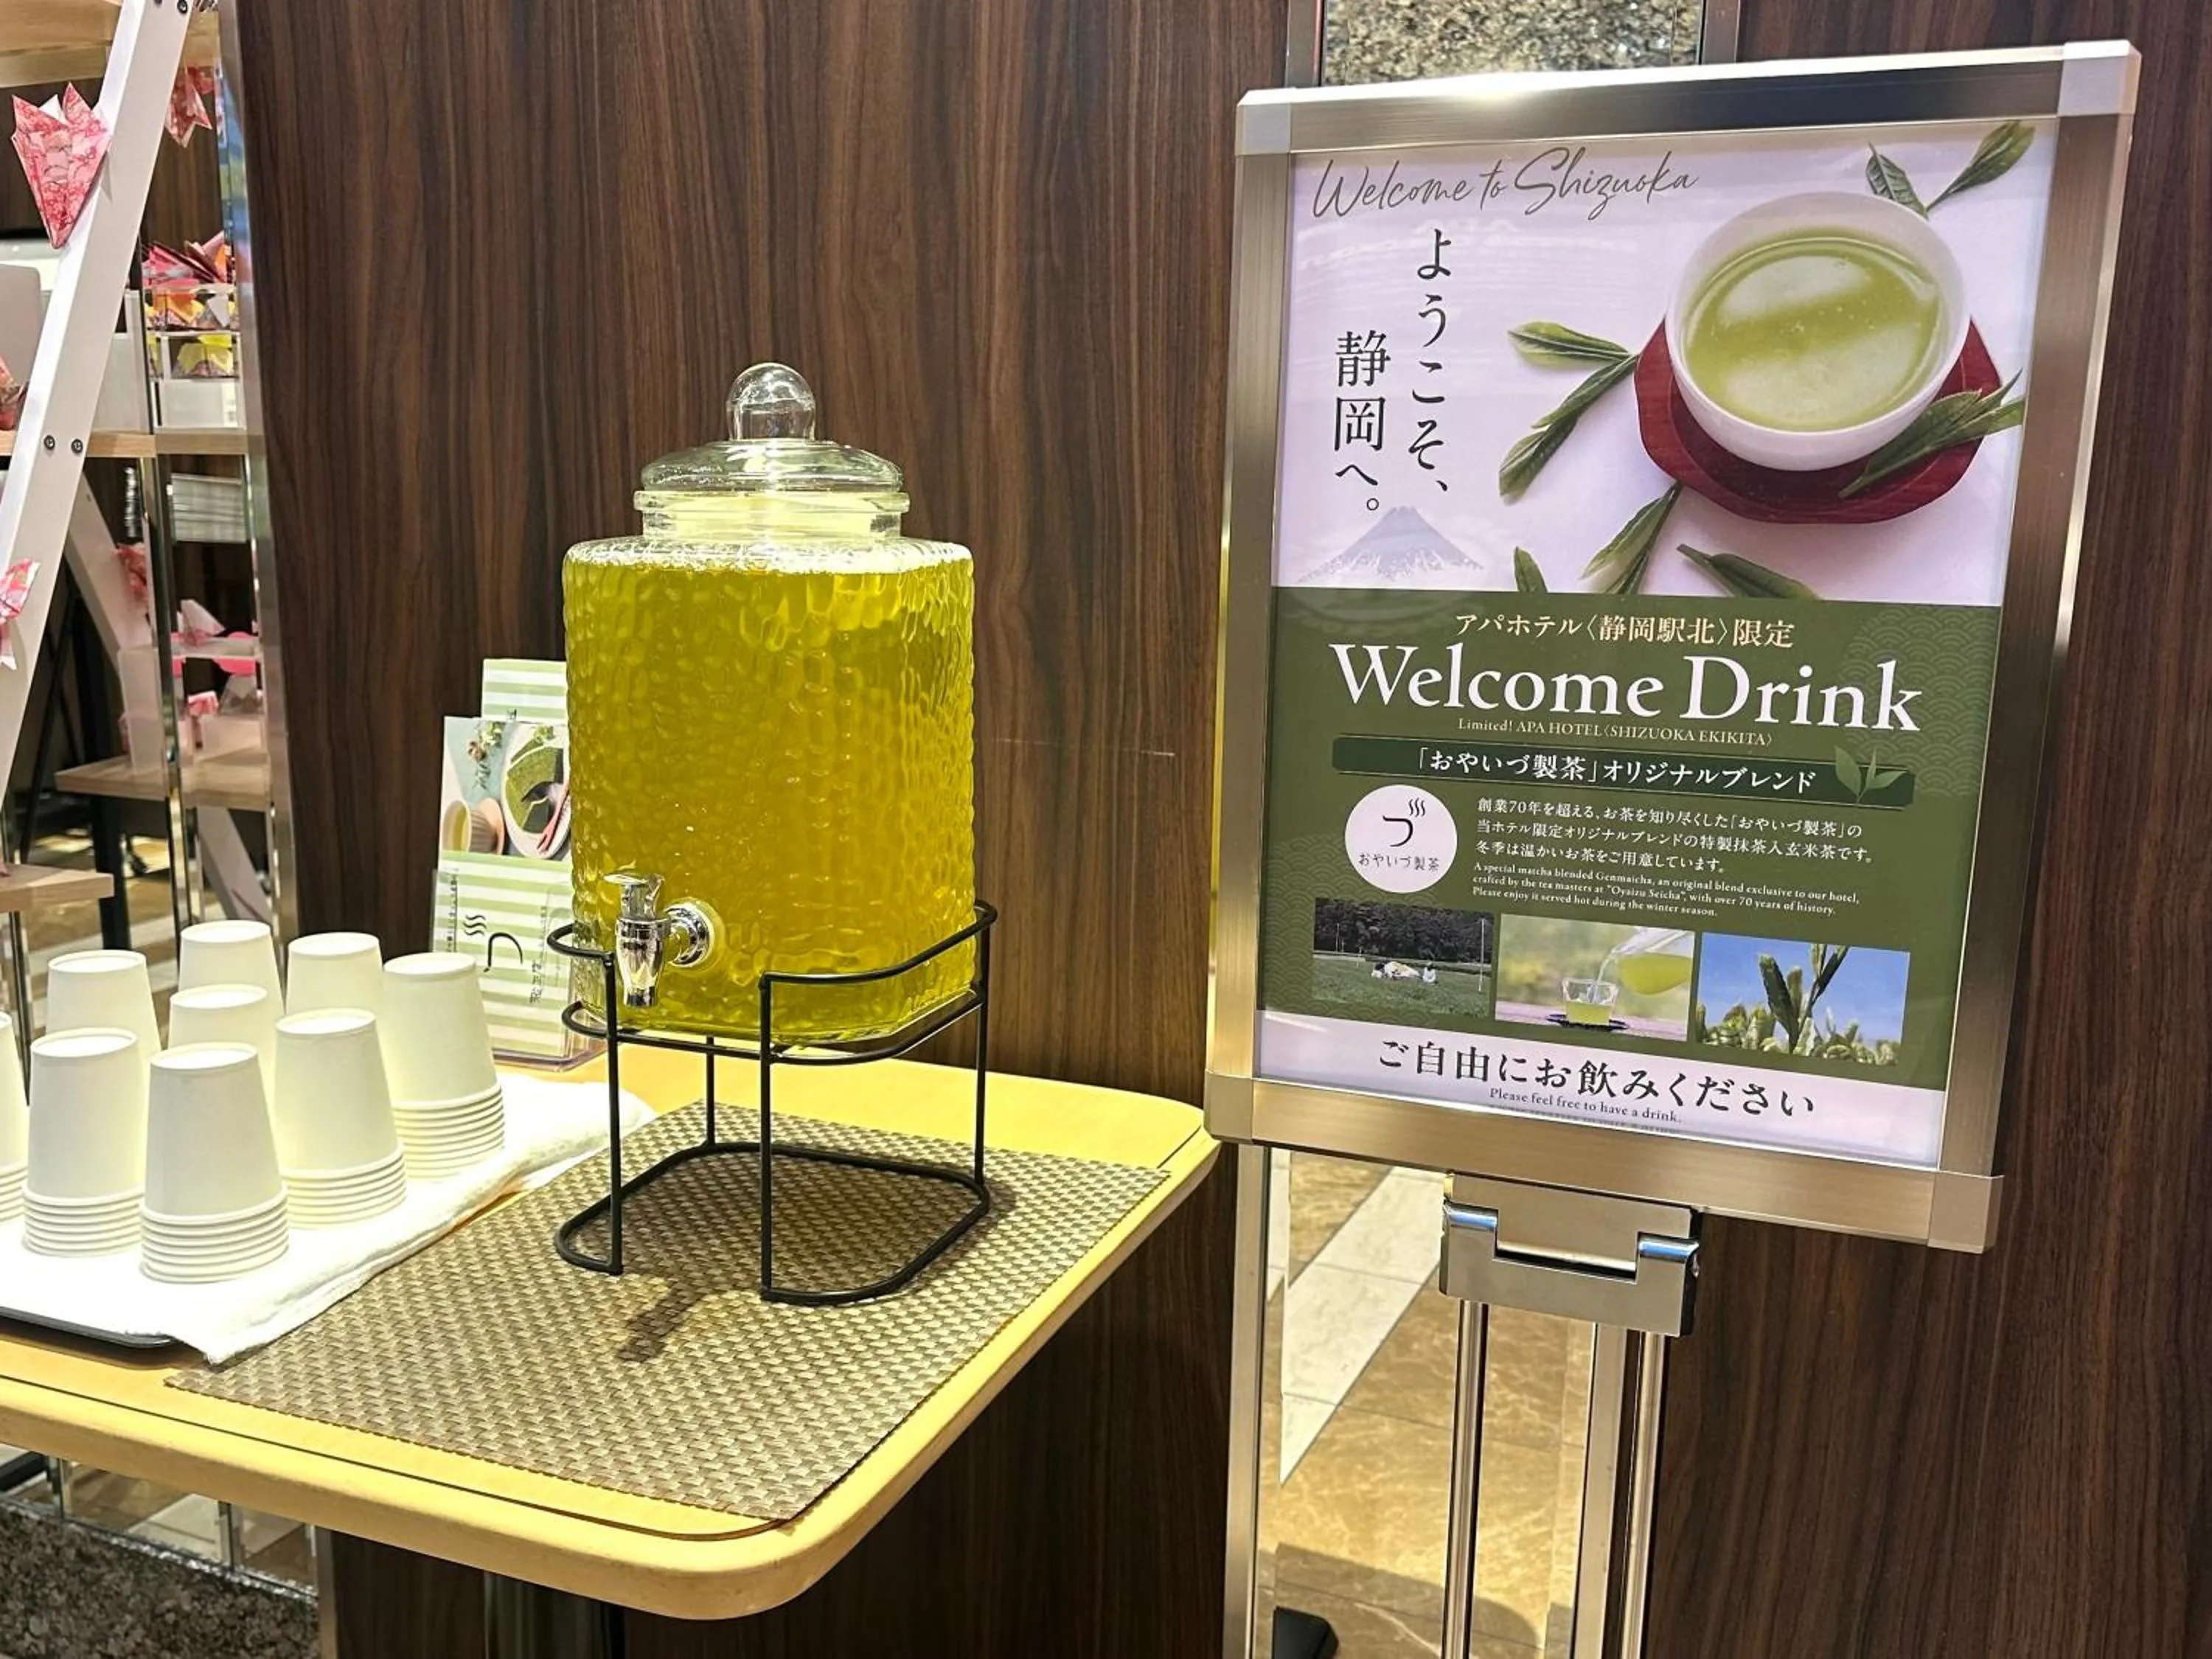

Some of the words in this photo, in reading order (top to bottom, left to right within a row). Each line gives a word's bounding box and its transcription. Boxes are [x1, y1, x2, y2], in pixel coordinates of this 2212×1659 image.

[1313, 159, 1474, 218] Welcome
[1478, 160, 1508, 209] to
[1514, 147, 1699, 220] Shizuoka
[1408, 228, 1453, 492] ようこそ、
[1334, 330, 1391, 511] 静岡へ。
[1455, 613, 1795, 649] アパホテル〈静岡駅北〉限定
[1329, 643, 1663, 717] Welcome
[1681, 654, 1922, 731] Drink
[1458, 718, 1513, 732] Limited!
[1516, 721, 1545, 734] APA
[1418, 748, 1816, 793] 「おやいづ製茶」オリジナルブレンド
[1359, 852, 1439, 872] おやいづ製茶
[1475, 840, 1724, 874] 冬季は温かいお茶をご用意しています。
[1472, 874, 1505, 885] crafted
[1507, 876, 1520, 888] by
[1521, 878, 1536, 887] the
[1539, 880, 1552, 889] tea
[1555, 883, 1592, 892] masters
[1689, 893, 1711, 903] with
[1714, 897, 1736, 905] over
[1739, 897, 1753, 906] 70
[1755, 900, 1781, 911] years
[1784, 901, 1795, 911] of
[1797, 902, 1835, 917] history.
[1472, 887, 1502, 897] Please
[1504, 891, 1528, 902] enjoy
[1531, 891, 1539, 900] it
[1541, 893, 1571, 904] served
[1573, 895, 1590, 905] hot
[1592, 897, 1626, 910] during
[1628, 900, 1644, 909] the
[1646, 902, 1678, 913] winter
[1681, 906, 1717, 917] season.
[1474, 863, 1481, 871] A
[1484, 864, 1515, 874] special
[1518, 867, 1552, 877] matcha
[1555, 869, 1593, 880] blended
[1596, 872, 1655, 886] Genmaicha,
[1673, 880, 1713, 891] original
[1715, 881, 1744, 893] blend
[1746, 885, 1792, 897] exclusive
[1795, 889, 1806, 898] to
[1808, 892, 1826, 900] our
[1829, 891, 1860, 905] hotel,
[1379, 1039, 1815, 1117] ご自由にお飲みください
[1489, 1088, 1528, 1103] Please
[1531, 1092, 1553, 1105] feel
[1557, 1095, 1581, 1108] free
[1585, 1102, 1596, 1110] to
[1600, 1101, 1628, 1116] have
[1642, 1108, 1683, 1123] drink.
